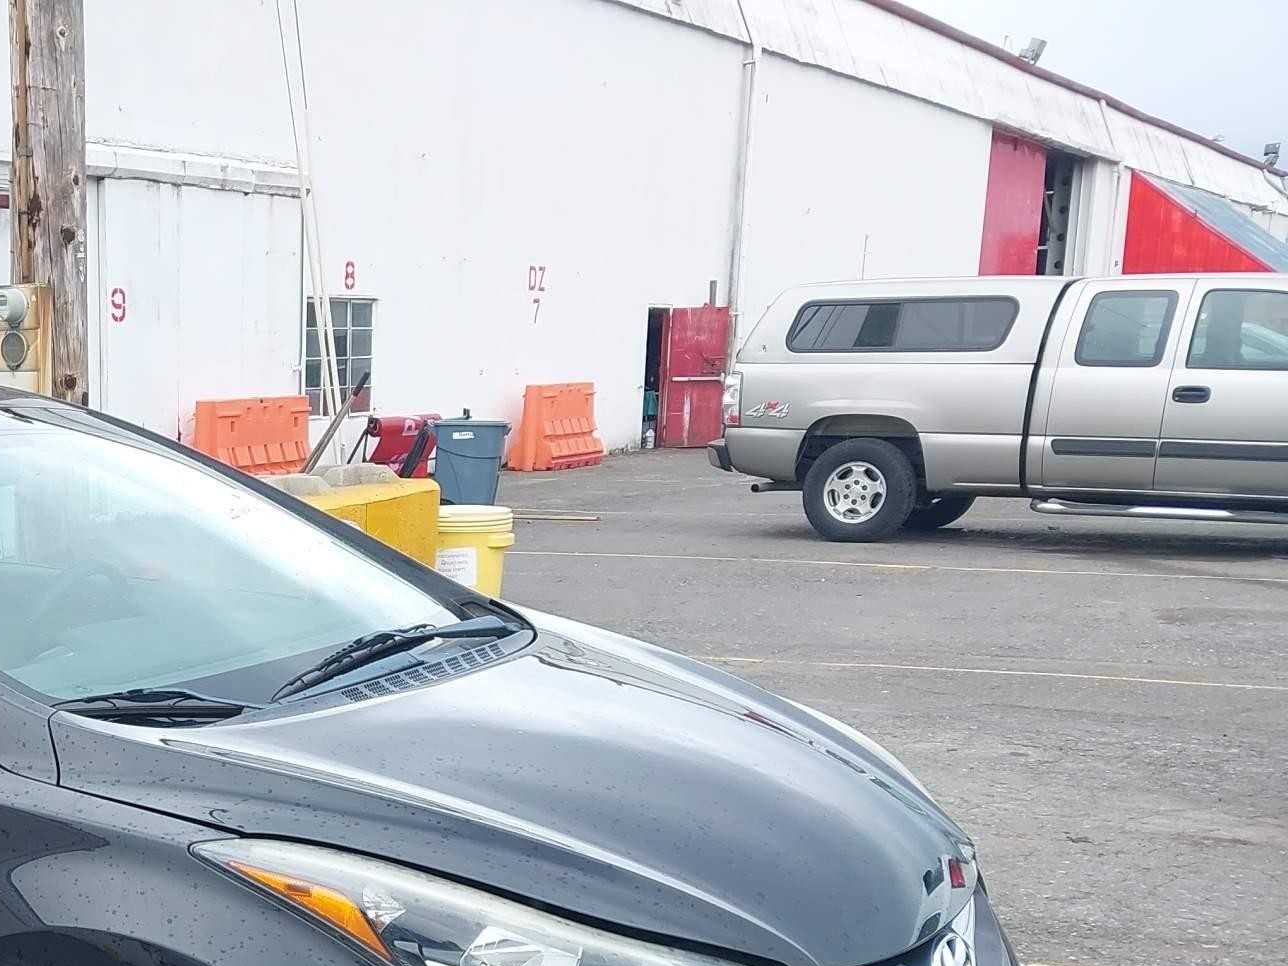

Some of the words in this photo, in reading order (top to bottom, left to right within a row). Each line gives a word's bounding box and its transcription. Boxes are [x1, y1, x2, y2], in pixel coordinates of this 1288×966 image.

[344, 261, 356, 290] 8
[528, 265, 546, 292] DZ
[111, 287, 126, 323] 9
[533, 298, 541, 324] 7
